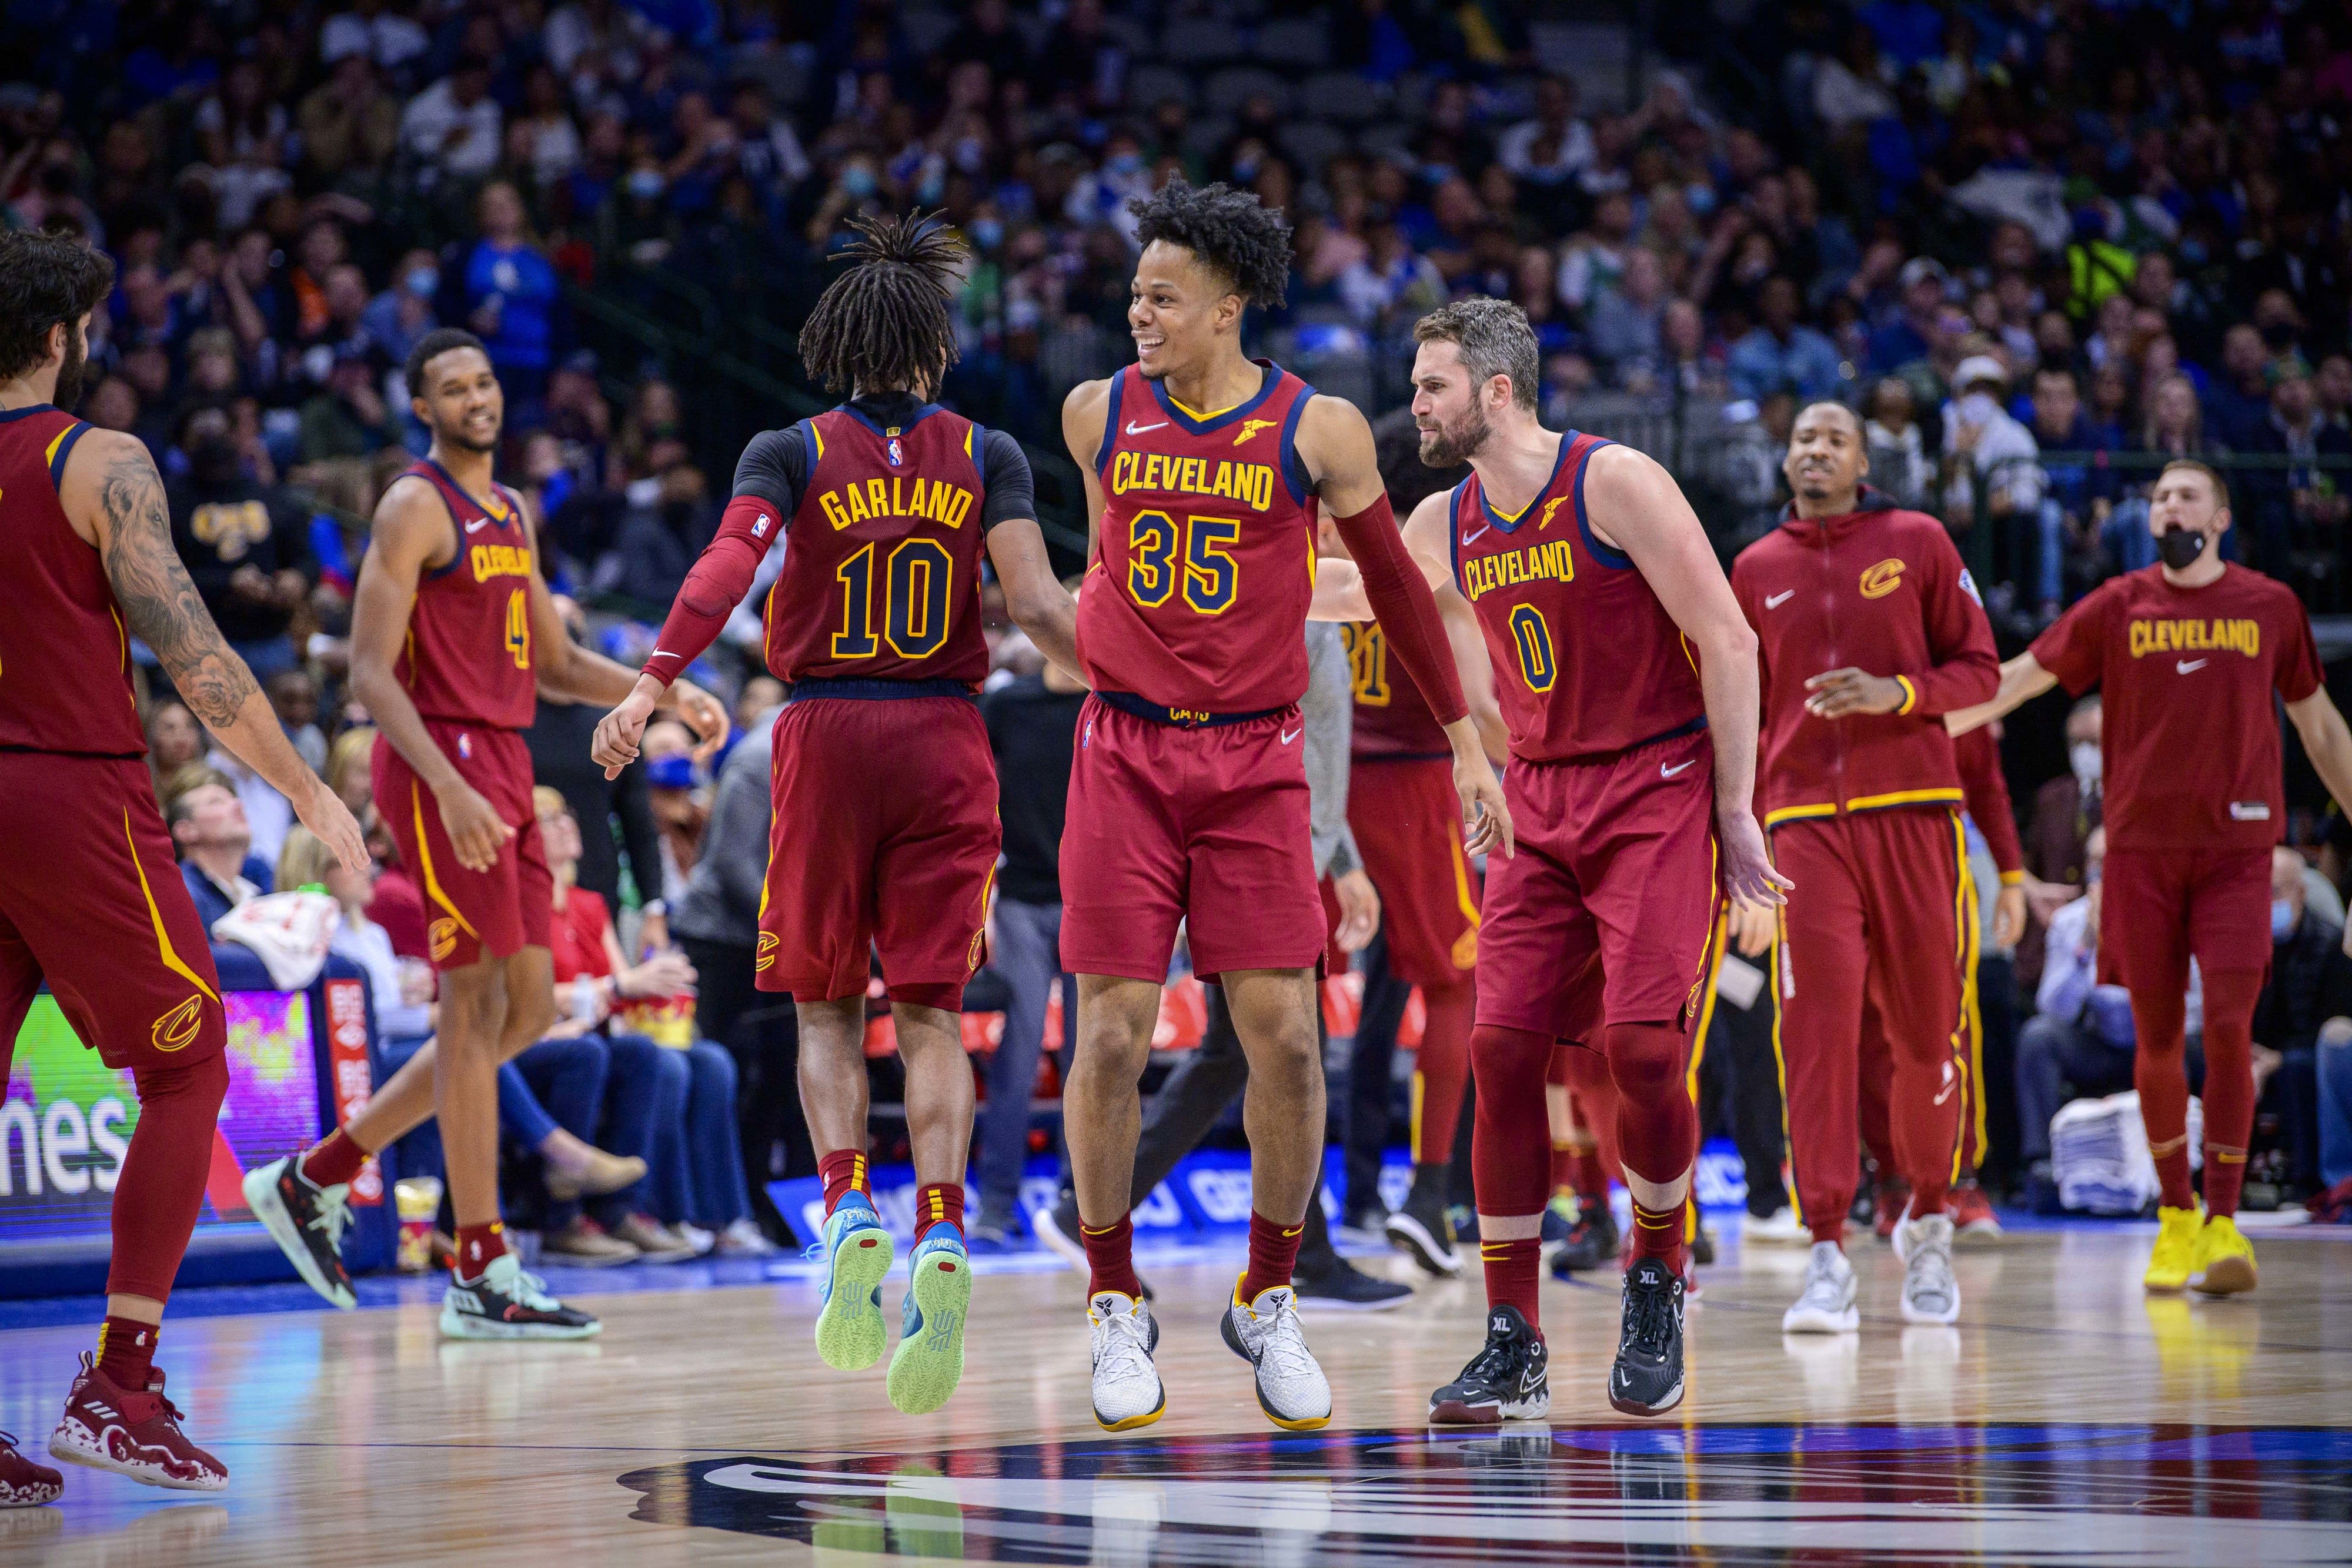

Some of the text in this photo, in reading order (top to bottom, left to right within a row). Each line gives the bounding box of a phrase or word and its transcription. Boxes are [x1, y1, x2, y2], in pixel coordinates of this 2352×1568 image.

[819, 477, 974, 531] GARLAND
[1112, 451, 1274, 512] CLEVELAND
[1128, 509, 1241, 615] 35
[1465, 540, 1575, 601] CLEVELAND
[505, 587, 530, 669] 4
[831, 538, 953, 659] 10
[1508, 602, 1557, 693] 0
[2130, 618, 2260, 658] CLEVELAND
